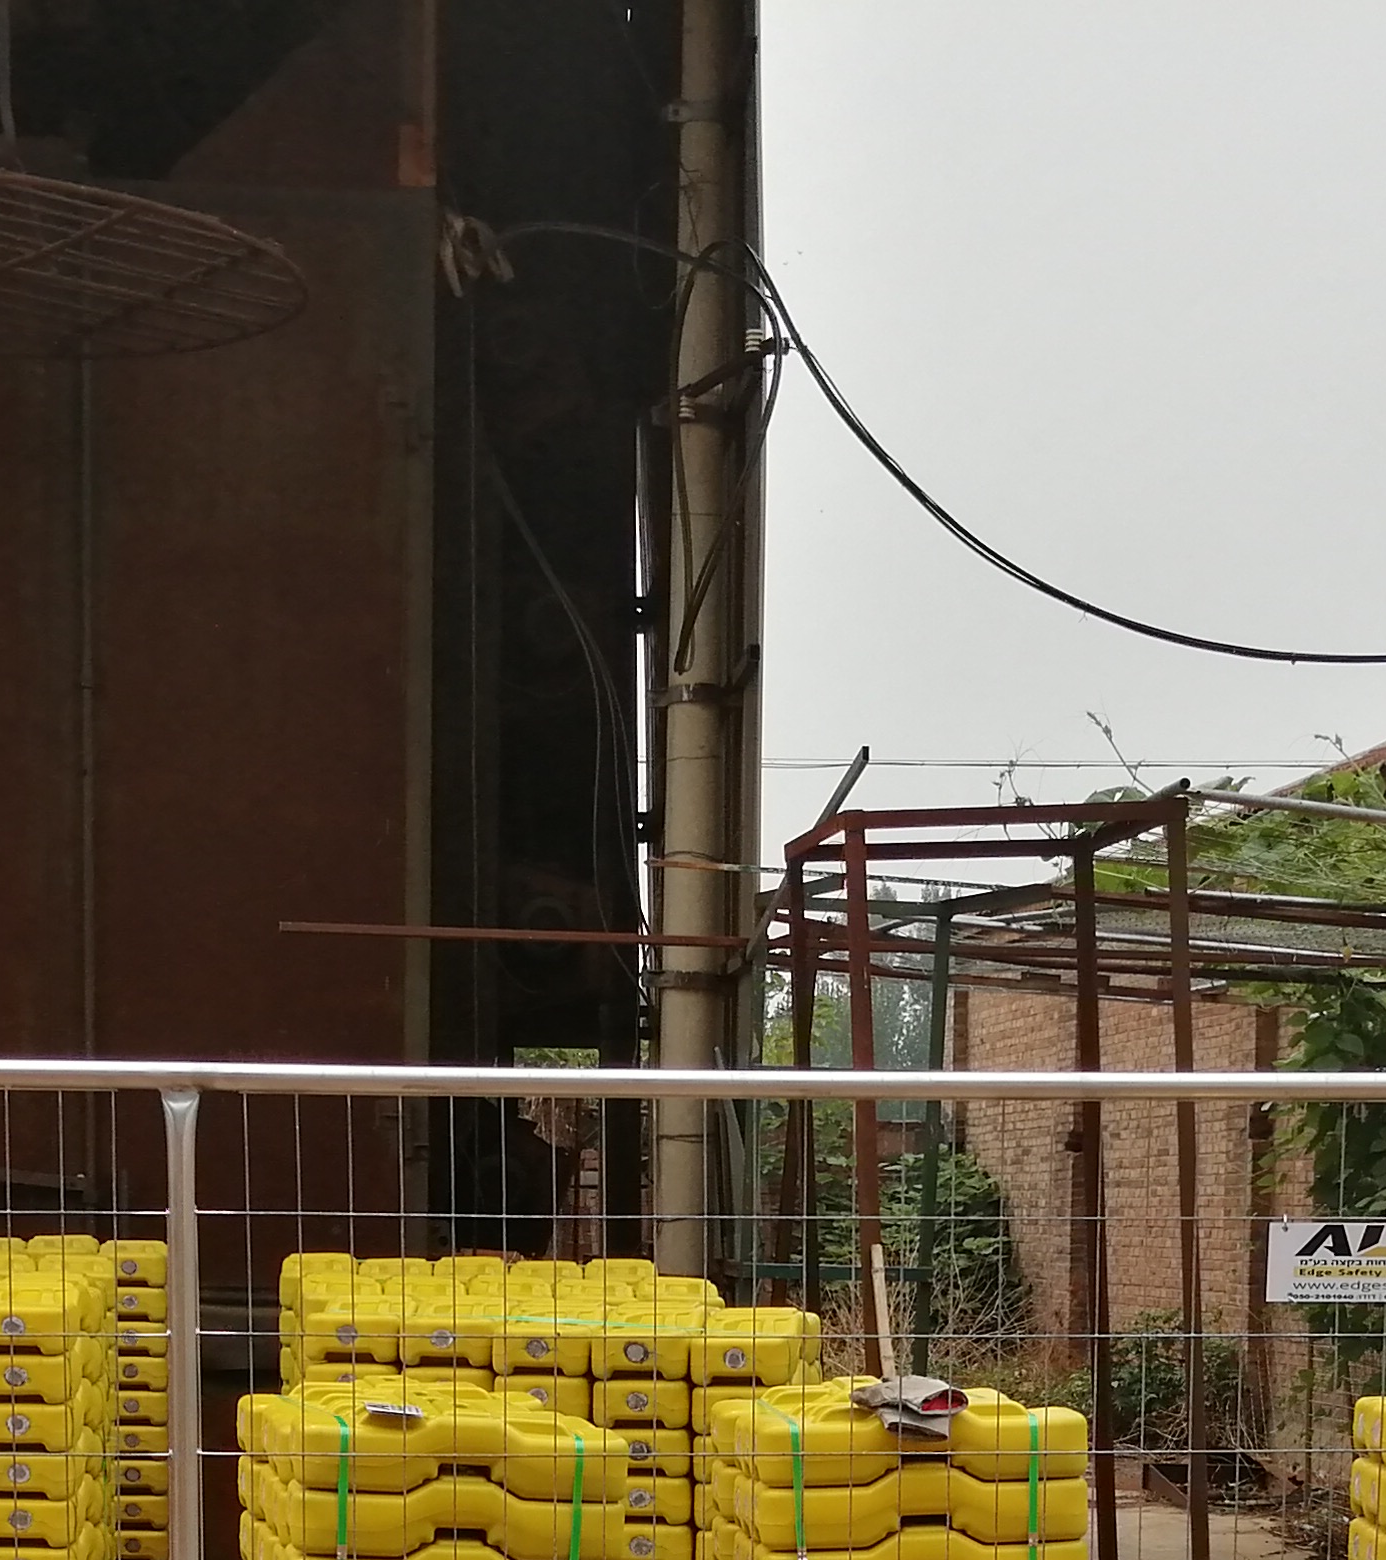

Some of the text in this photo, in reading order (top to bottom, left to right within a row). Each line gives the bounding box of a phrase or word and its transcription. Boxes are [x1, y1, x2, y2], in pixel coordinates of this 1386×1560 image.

[1331, 1259, 1362, 1267] בקצה
[1299, 1269, 1332, 1277] Edge
[1338, 1269, 1382, 1277] Safety
